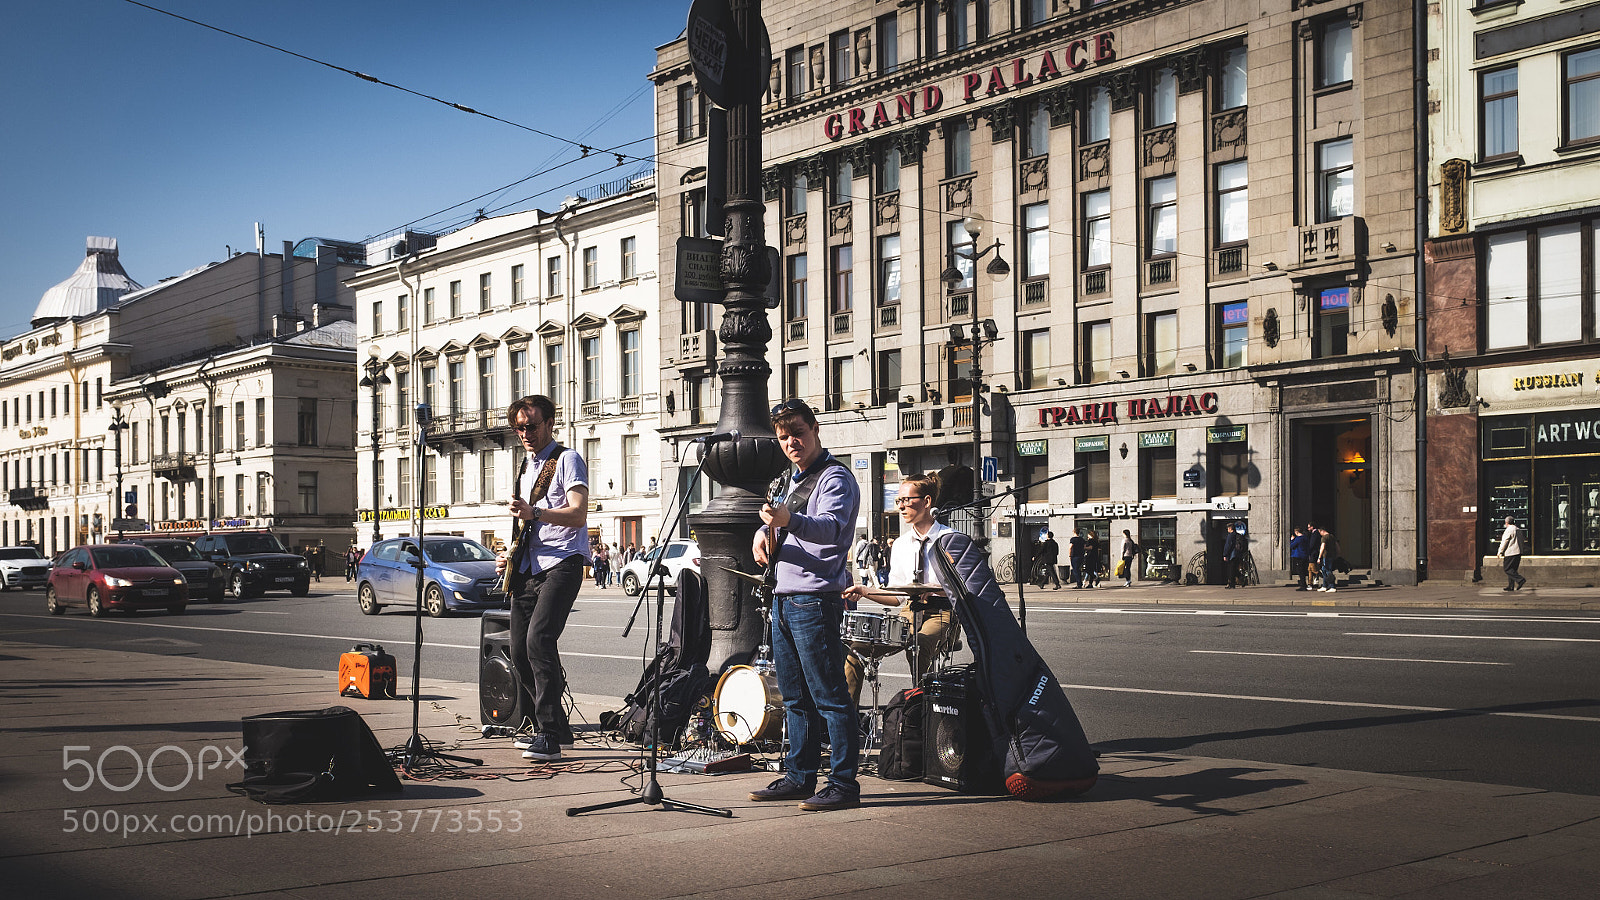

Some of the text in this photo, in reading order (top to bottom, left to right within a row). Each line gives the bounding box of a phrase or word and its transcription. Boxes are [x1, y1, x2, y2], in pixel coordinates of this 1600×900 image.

[695, 27, 724, 60] ЧЕКИ
[824, 31, 1116, 142] GRAND PALACE
[1513, 372, 1583, 391] RUSSIAN
[1038, 392, 1218, 426] ГРАНД ПАЛАС
[1211, 430, 1242, 439] СОБРАНИЕ
[1537, 423, 1571, 443] ART
[368, 509, 409, 521] ТЕТРАЛЬНАЯ
[1091, 503, 1152, 517] СЕВЕР
[1028, 675, 1049, 706] mono
[932, 703, 959, 716] Hartke
